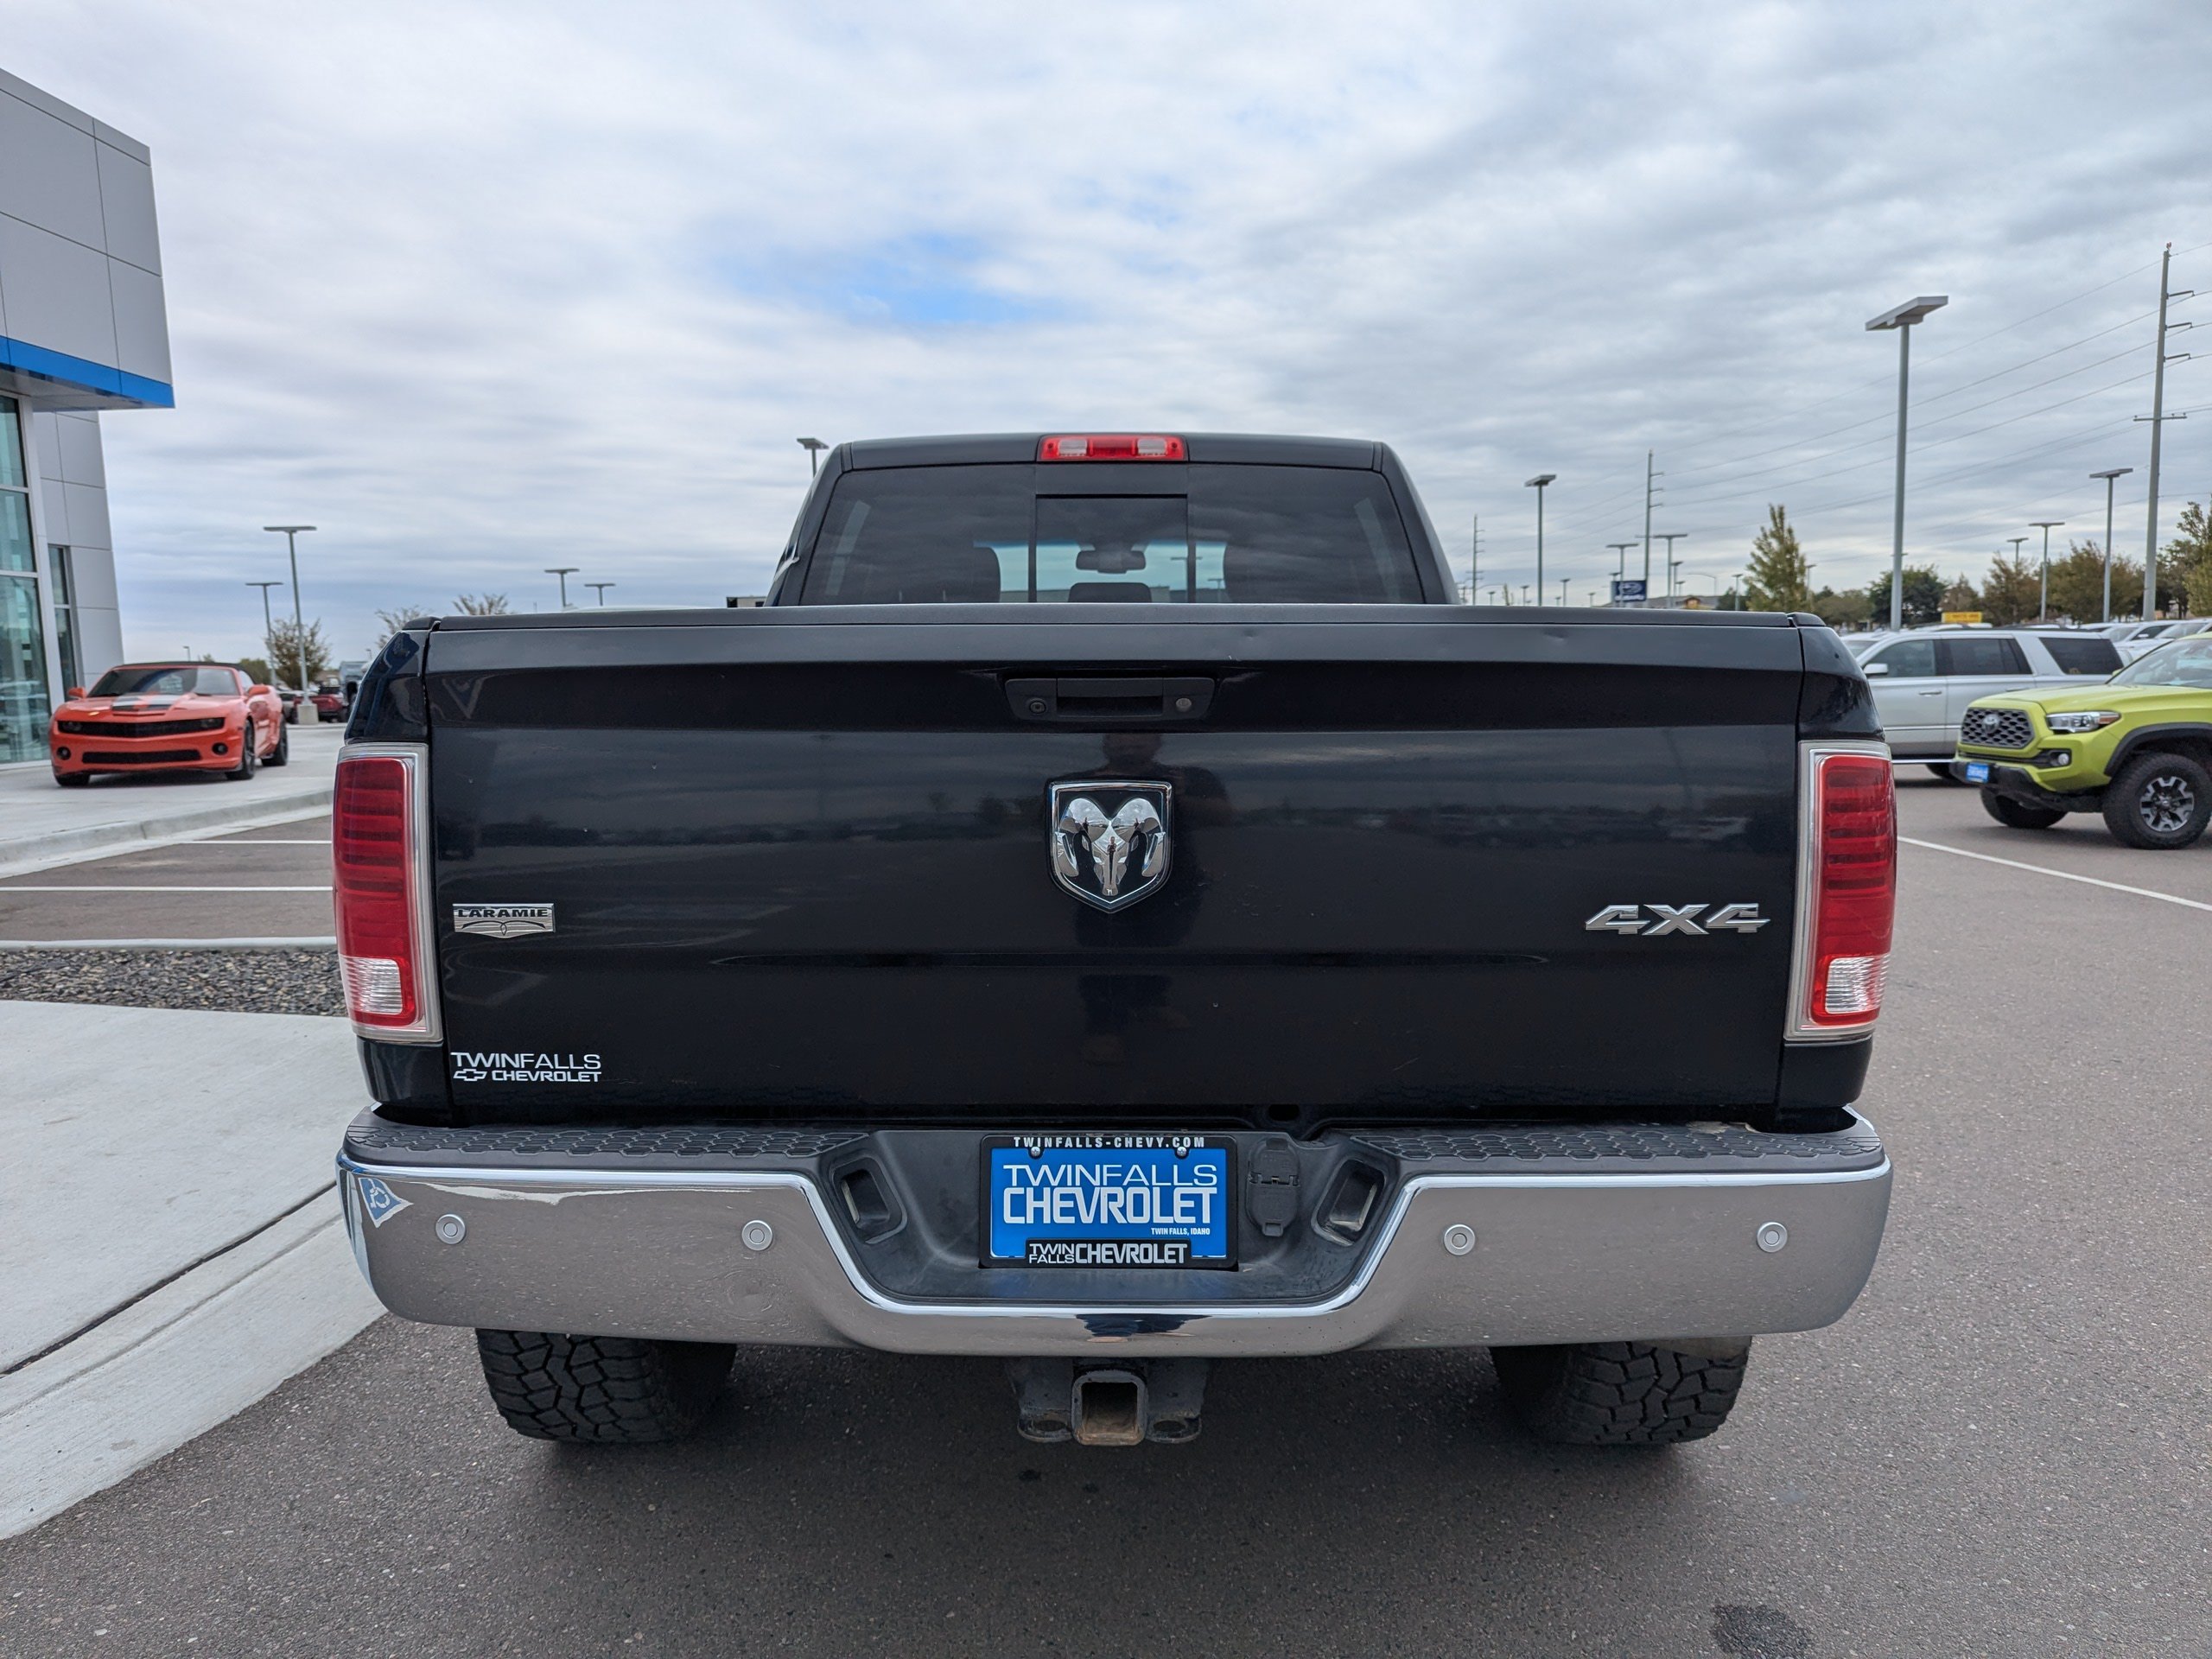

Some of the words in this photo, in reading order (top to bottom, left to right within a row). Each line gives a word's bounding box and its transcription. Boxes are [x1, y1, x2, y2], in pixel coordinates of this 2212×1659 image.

[458, 909, 548, 918] LARAMIE
[450, 1052, 601, 1069] TWINFALLS
[492, 1070, 601, 1083] CHEVROLET
[1014, 1136, 1205, 1148] TWINFALLS-CHEVY.COM
[1003, 1164, 1217, 1186] TWINFALLS
[1003, 1186, 1217, 1224] CHEVROLET
[1169, 1228, 1190, 1236] FALLS,
[1029, 1243, 1074, 1255] TWIN
[1075, 1243, 1188, 1264] CHEVROLET
[1029, 1254, 1075, 1264] FALLS
